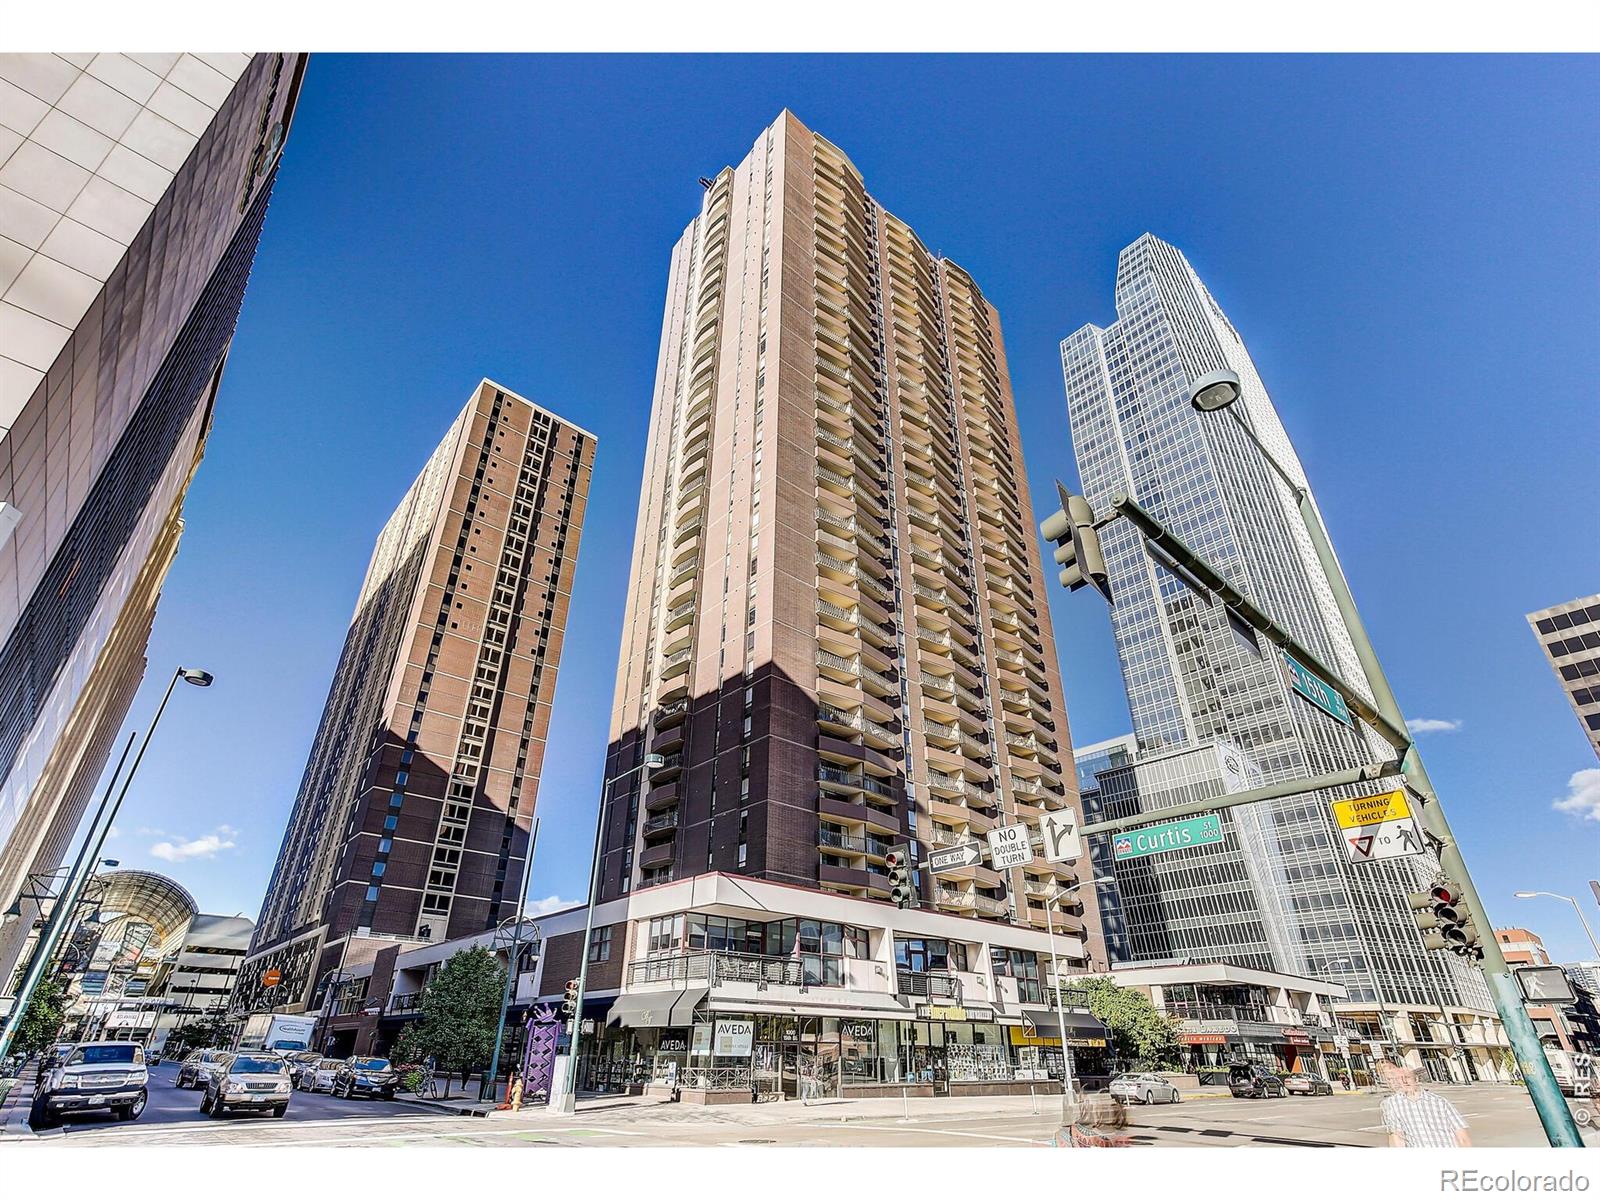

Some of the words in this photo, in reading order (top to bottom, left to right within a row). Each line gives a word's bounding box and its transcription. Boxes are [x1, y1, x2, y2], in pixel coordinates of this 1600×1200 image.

[1301, 672, 1332, 709] 15th
[1348, 798, 1390, 812] TURNING
[1350, 808, 1397, 823] VEHICLES
[1203, 820, 1212, 829] St
[998, 828, 1017, 843] NO
[1136, 826, 1192, 852] Curtis
[1200, 828, 1219, 839] 1000
[994, 840, 1028, 856] DOUBLE
[1378, 836, 1391, 846] TO
[934, 855, 949, 866] ONE
[950, 851, 965, 863] WAY
[1000, 852, 1025, 866] TURN
[717, 1023, 752, 1035] AVEDA
[841, 1025, 873, 1037] AVEDA
[660, 1039, 686, 1051] AVEDA
